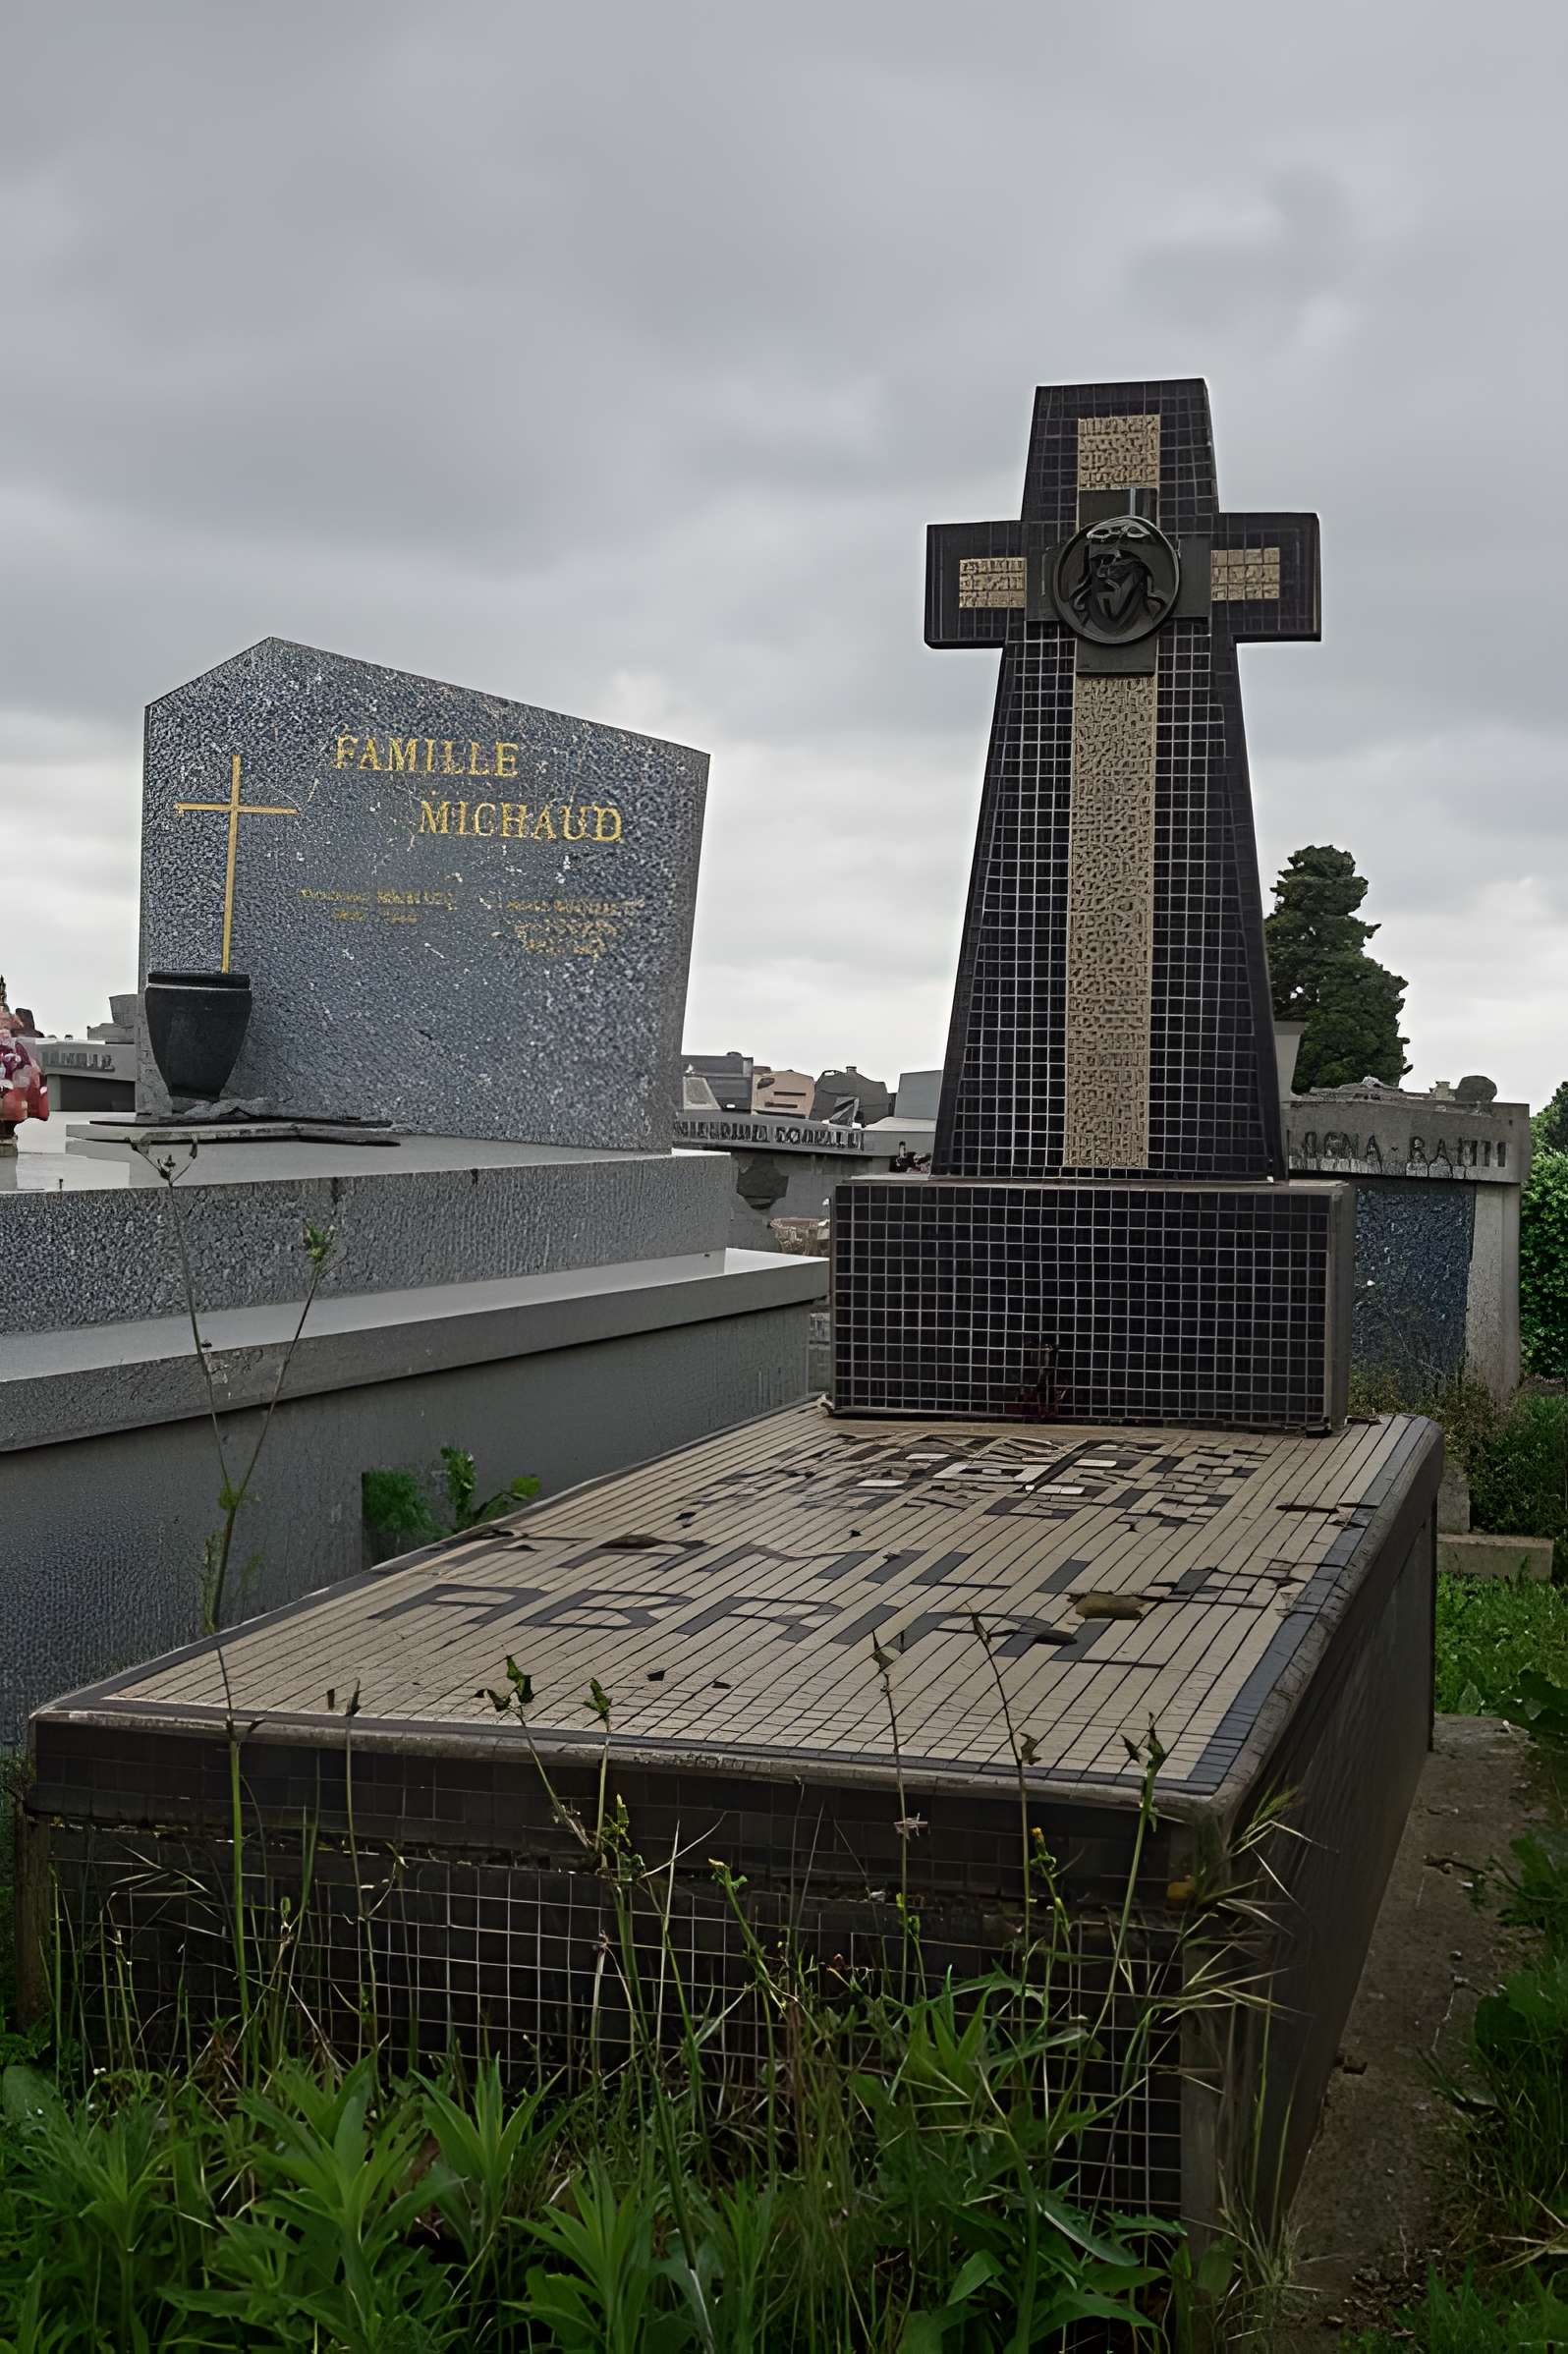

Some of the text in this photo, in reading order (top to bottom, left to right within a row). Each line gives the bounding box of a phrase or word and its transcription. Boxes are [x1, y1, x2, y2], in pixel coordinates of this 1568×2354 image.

[334, 734, 520, 778] FAMILLE
[419, 799, 624, 843] MICHAUD
[366, 1583, 1165, 1669] ABRIAL
